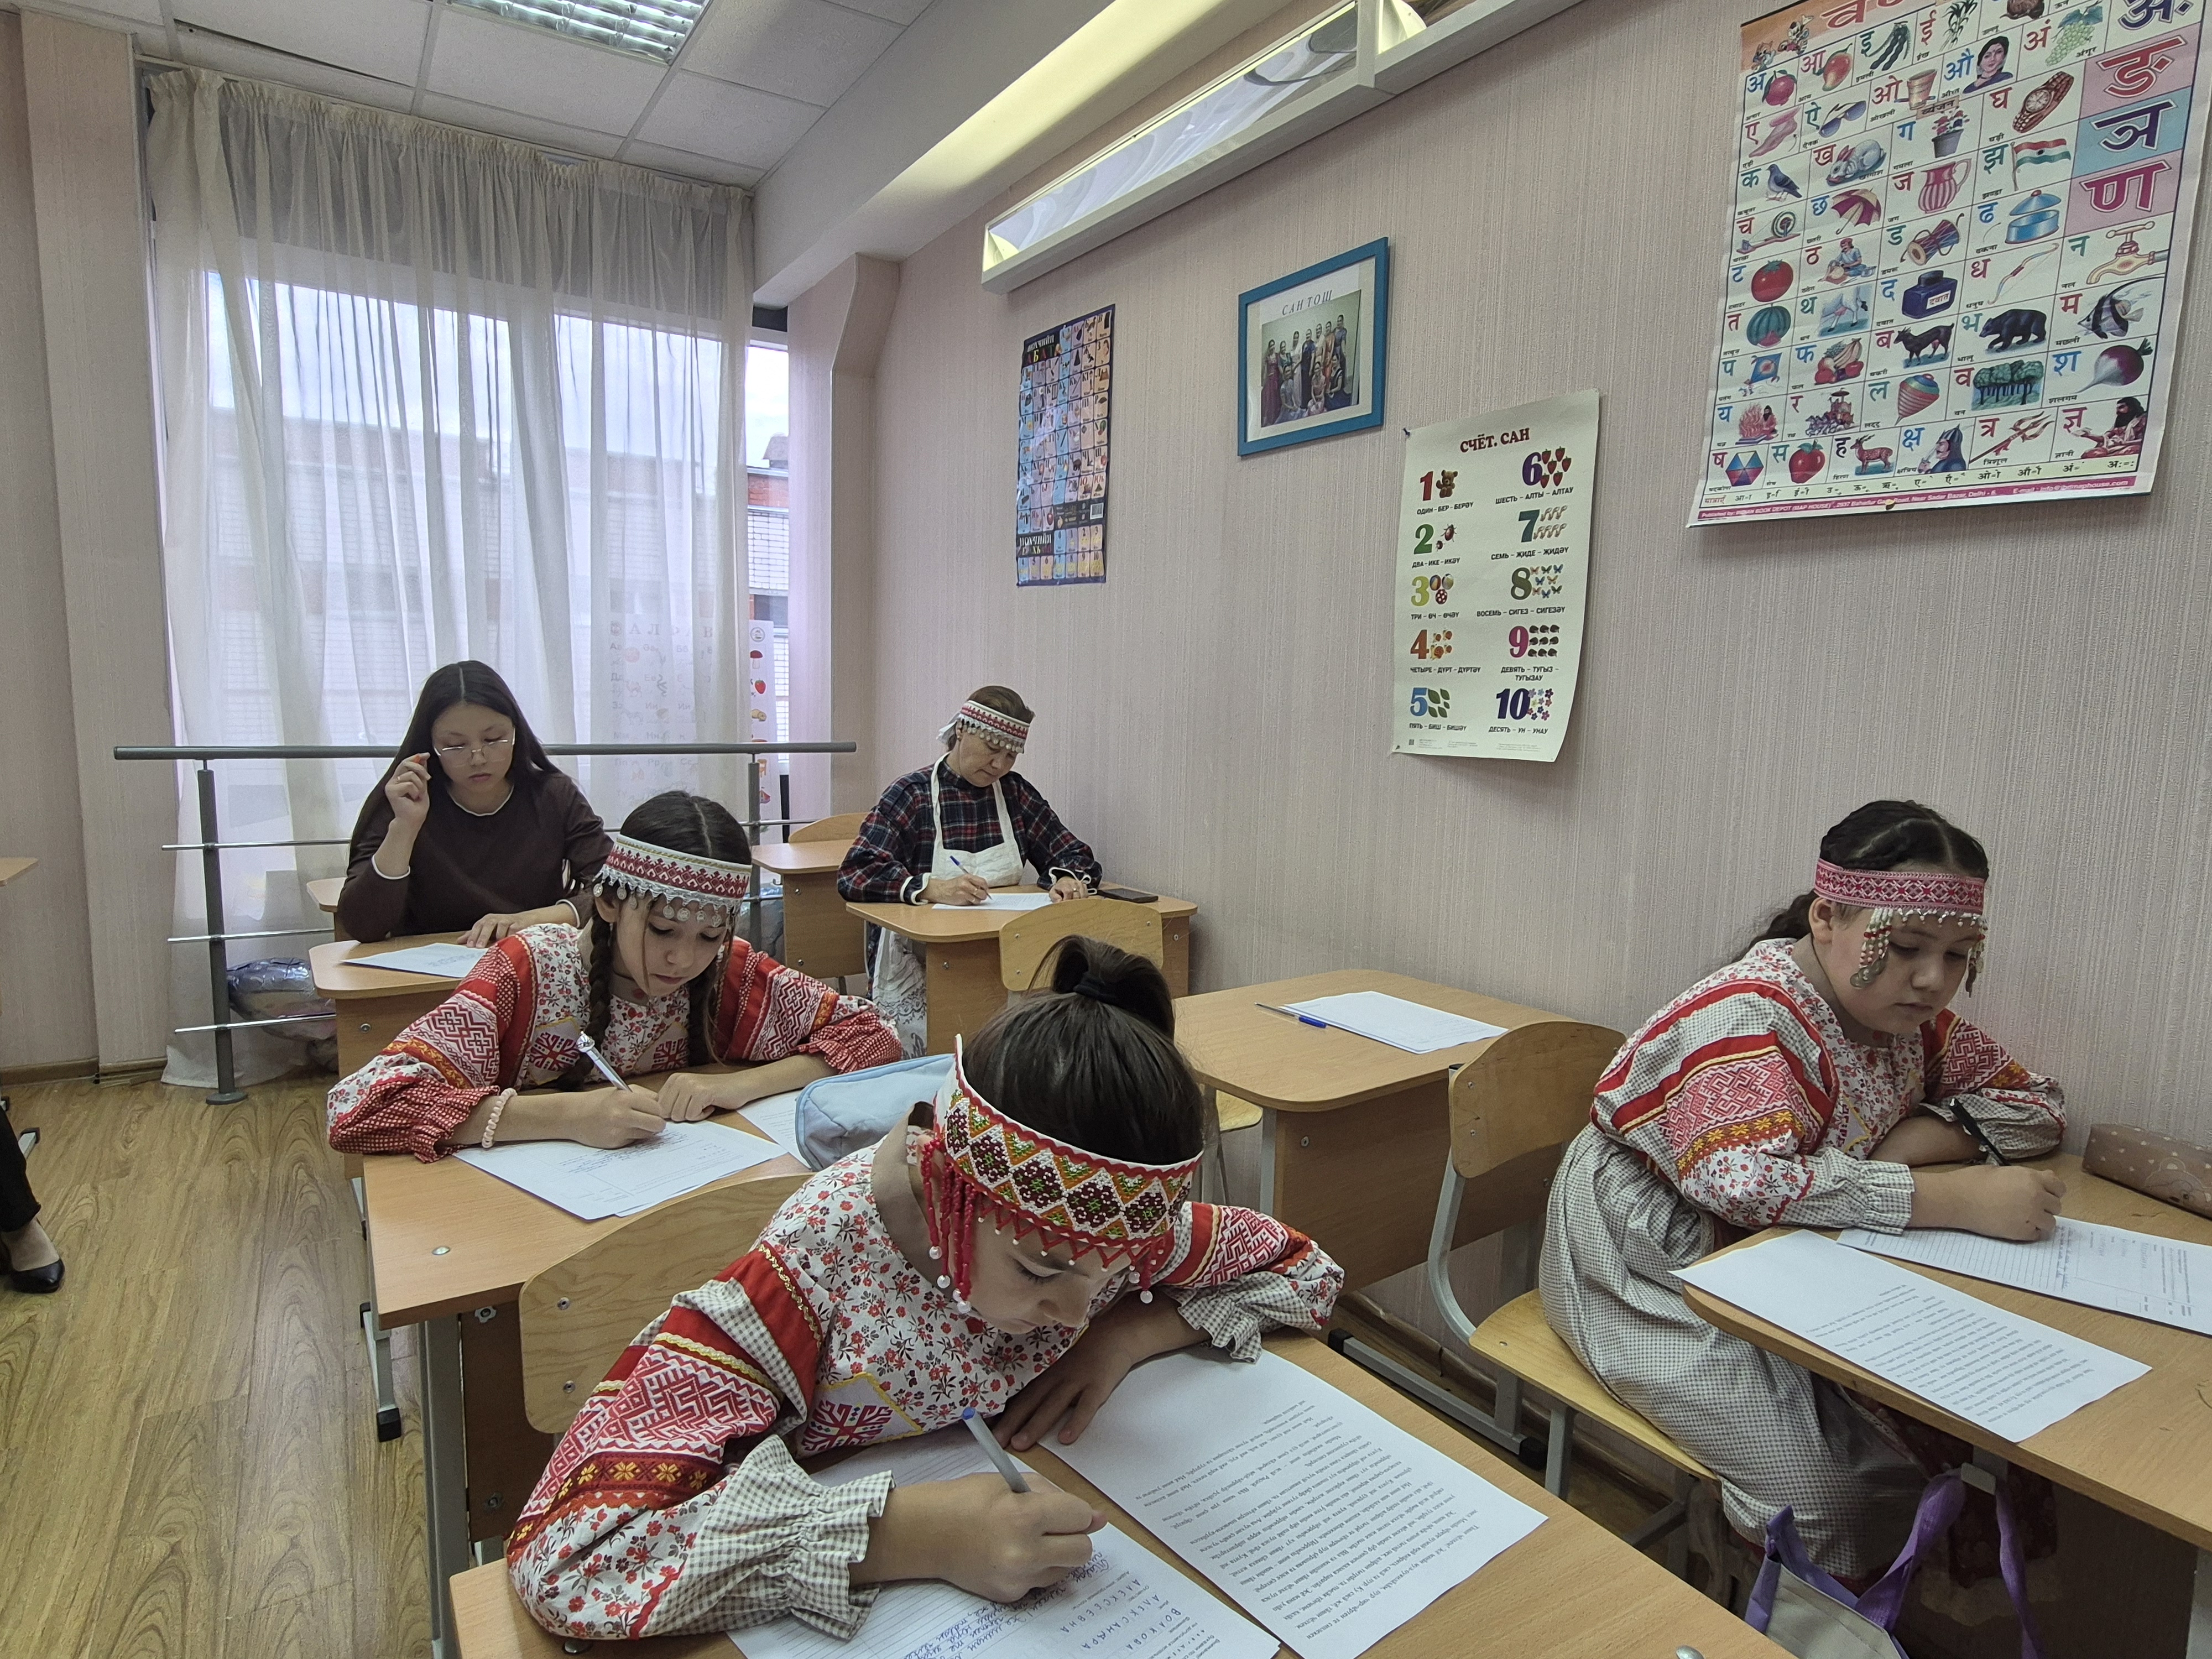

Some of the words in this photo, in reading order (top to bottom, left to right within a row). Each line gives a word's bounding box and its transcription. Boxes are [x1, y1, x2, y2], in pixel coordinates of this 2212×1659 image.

[1920, 9, 1937, 45] ई
[2023, 18, 2052, 51] अं
[1860, 30, 1875, 56] इ
[1944, 48, 1974, 81] औ
[1747, 72, 1764, 93] अ
[1871, 75, 1903, 105] ओ
[1990, 86, 2012, 109] घ
[1804, 102, 1822, 130] ऐ
[1745, 121, 1761, 145] ए
[1897, 121, 1916, 141] ग
[1813, 144, 1836, 166] ख
[1740, 168, 1762, 189] क
[1891, 171, 1915, 191] ज
[2079, 159, 2172, 212] ण
[1811, 195, 1830, 216] छ
[1977, 201, 1999, 224] ढ
[1736, 217, 1755, 236] च
[1886, 225, 1906, 246] ड
[1805, 246, 1823, 265] ठ
[2068, 234, 2090, 257] न
[1731, 264, 1746, 283] ट
[1971, 258, 1991, 279] ध
[1881, 279, 1898, 301] द
[1800, 296, 1818, 314] थ
[2060, 293, 2083, 314] म
[1727, 313, 1742, 332] त
[1961, 313, 1983, 332] भ
[1876, 330, 1894, 349] ब
[1795, 345, 1817, 363] फ
[2052, 351, 2082, 377] श
[1722, 359, 1737, 376] प
[1954, 367, 1975, 387] व
[1869, 380, 1891, 402] ल
[1718, 405, 1733, 422] य
[1791, 395, 1804, 413] र
[1979, 417, 2000, 437] त्र
[1460, 434, 1498, 453] СЧЁТ.
[1500, 427, 1530, 445] САН
[1835, 436, 1851, 458] ह
[1713, 451, 1728, 468] ष
[1772, 444, 1789, 463] स
[1522, 452, 1542, 486] 6
[1420, 471, 1434, 501] 1
[1495, 495, 1518, 504] ШЕСТЬ
[1552, 487, 1574, 497] АЛТАУ
[1416, 506, 1433, 515] ОДИН
[1518, 509, 1540, 542] 7
[1413, 524, 1434, 555] 2
[1412, 560, 1424, 568] ДВА
[1411, 576, 1430, 607] 3
[1510, 567, 1532, 600] 8
[1410, 629, 1430, 660] 4
[1509, 625, 1530, 658] 9
[1410, 687, 1428, 717] 5
[1496, 688, 1531, 720] 10
